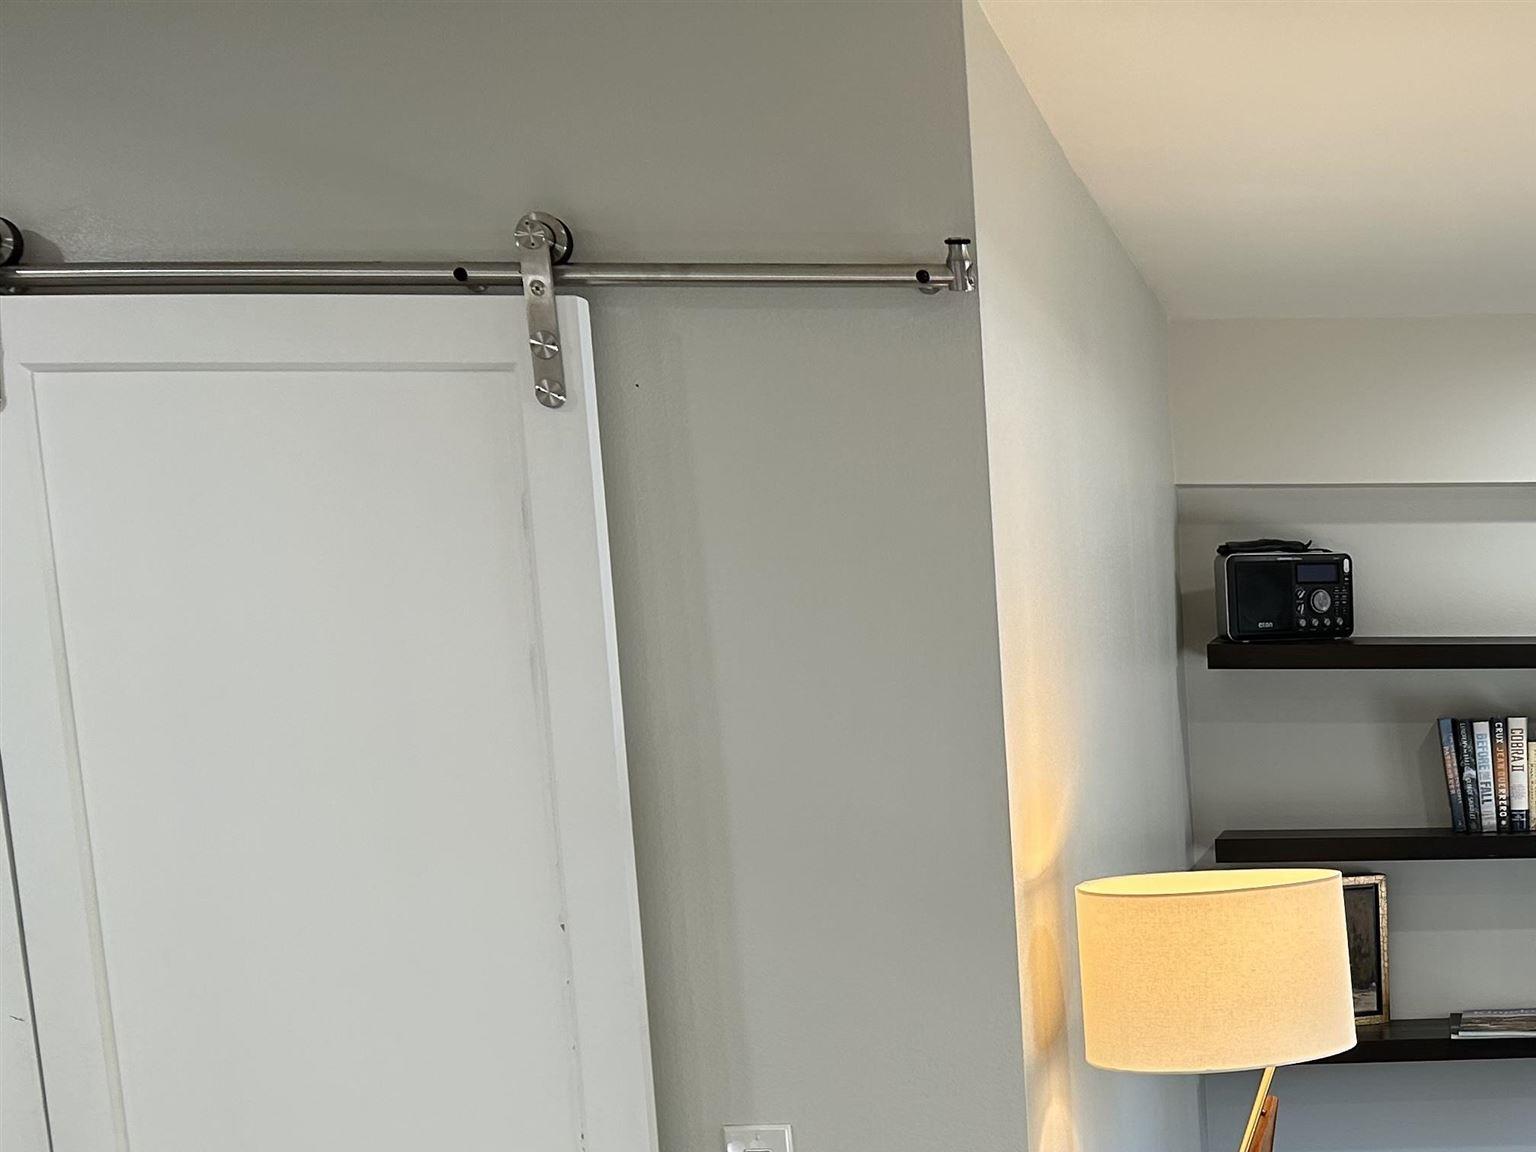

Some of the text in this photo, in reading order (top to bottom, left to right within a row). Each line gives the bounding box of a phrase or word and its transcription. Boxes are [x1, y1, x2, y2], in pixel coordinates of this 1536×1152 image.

[1476, 733, 1491, 770] BEFORE
[1495, 722, 1508, 818] CRUX JEAN GUERRERO
[1510, 728, 1525, 773] COBRA II
[1480, 780, 1494, 805] FALL
